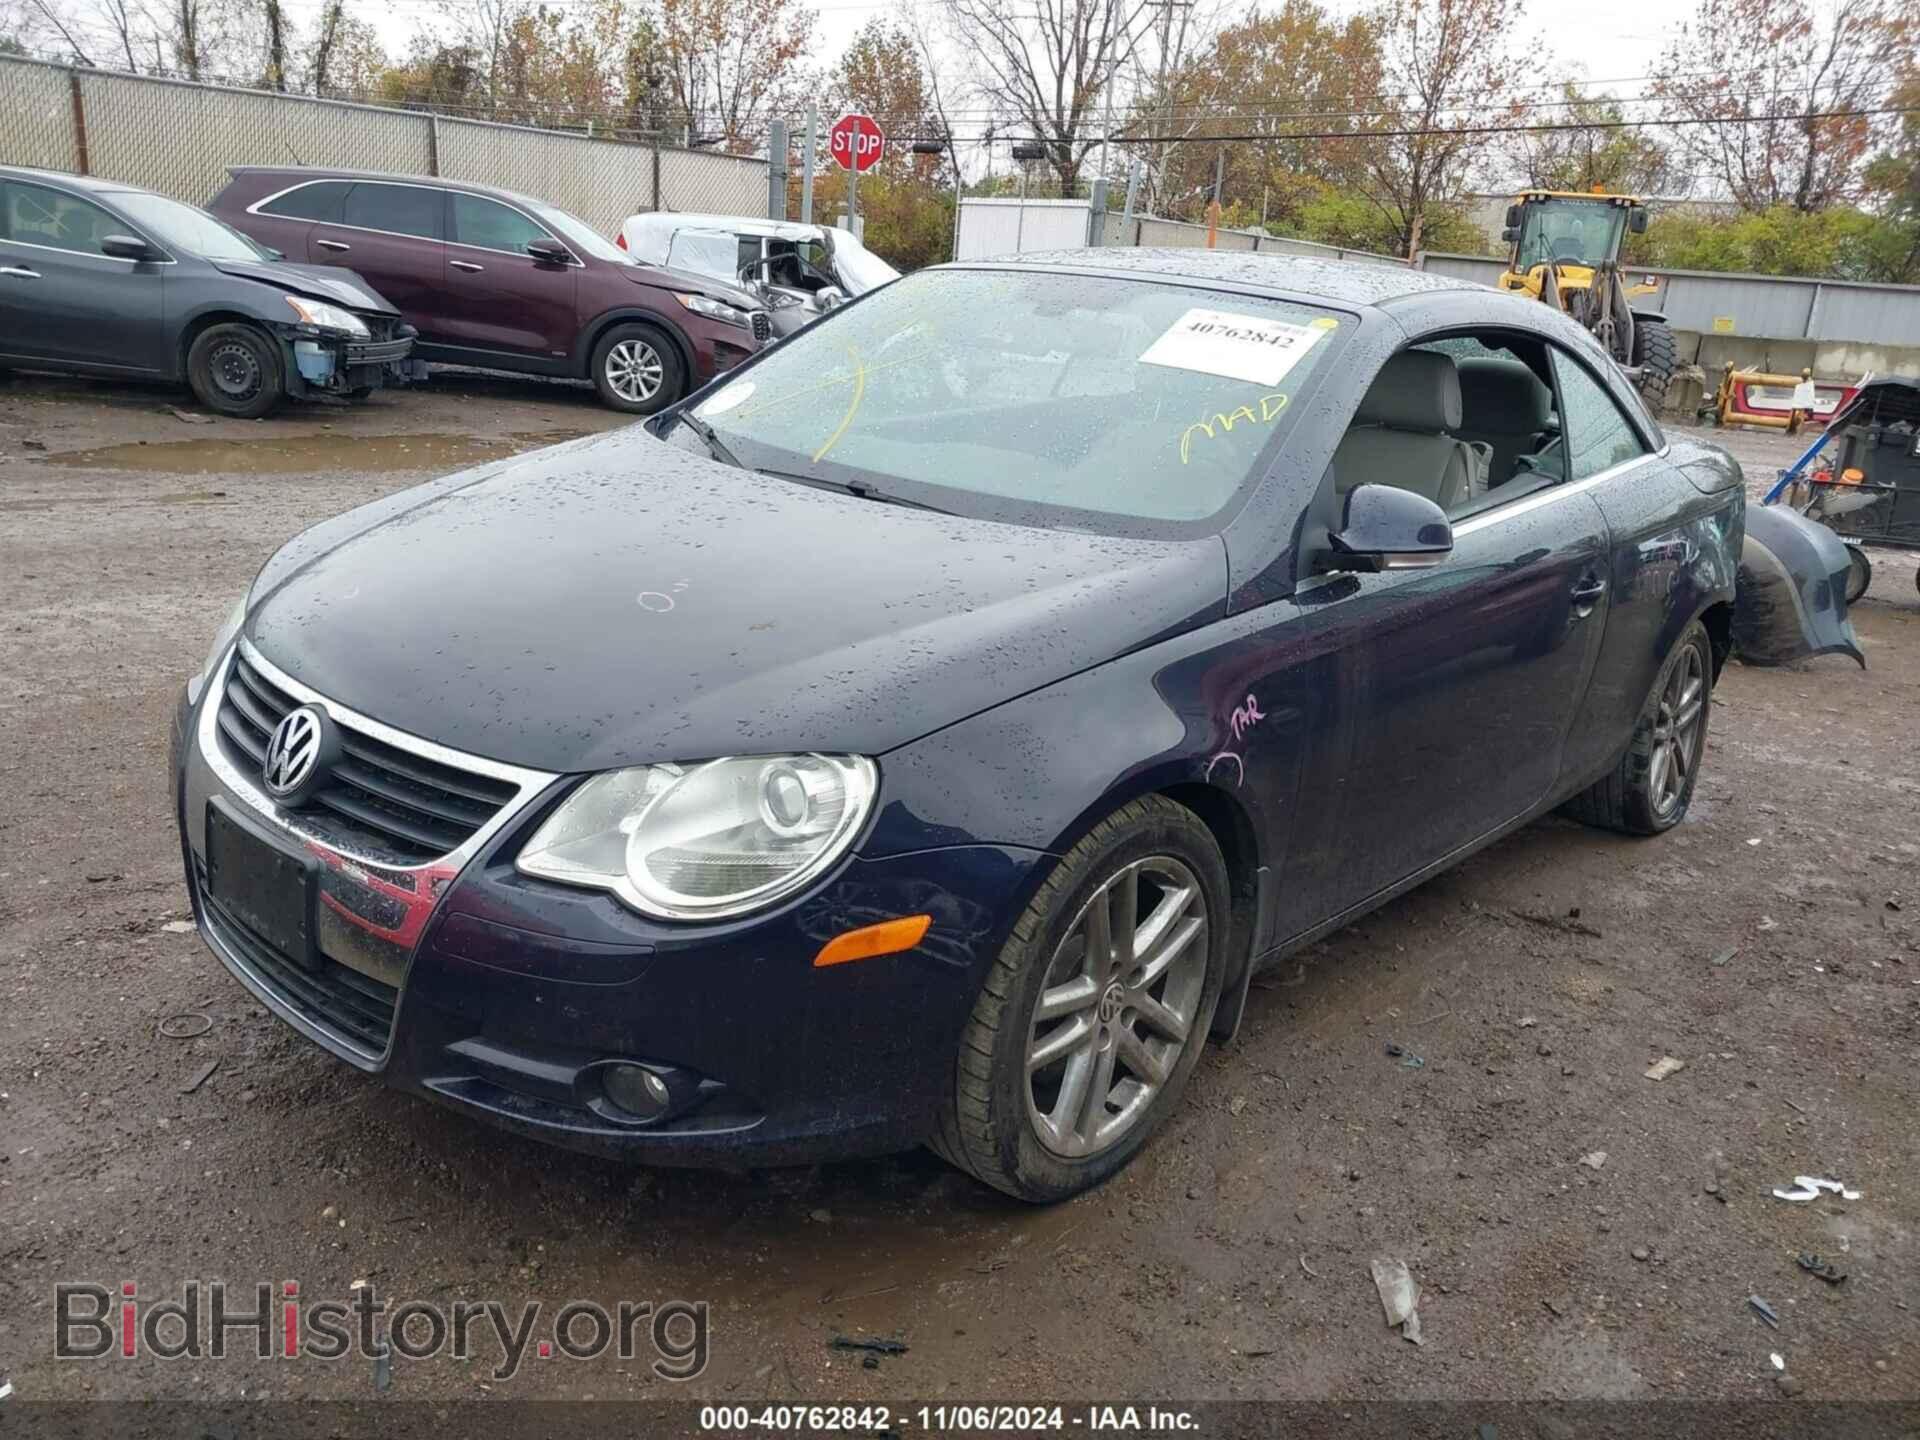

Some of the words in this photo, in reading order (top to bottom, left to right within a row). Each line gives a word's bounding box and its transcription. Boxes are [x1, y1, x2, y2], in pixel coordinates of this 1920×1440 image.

[833, 130, 880, 155] STOP
[1187, 320, 1296, 350] 40762842
[264, 707, 321, 796] VW
